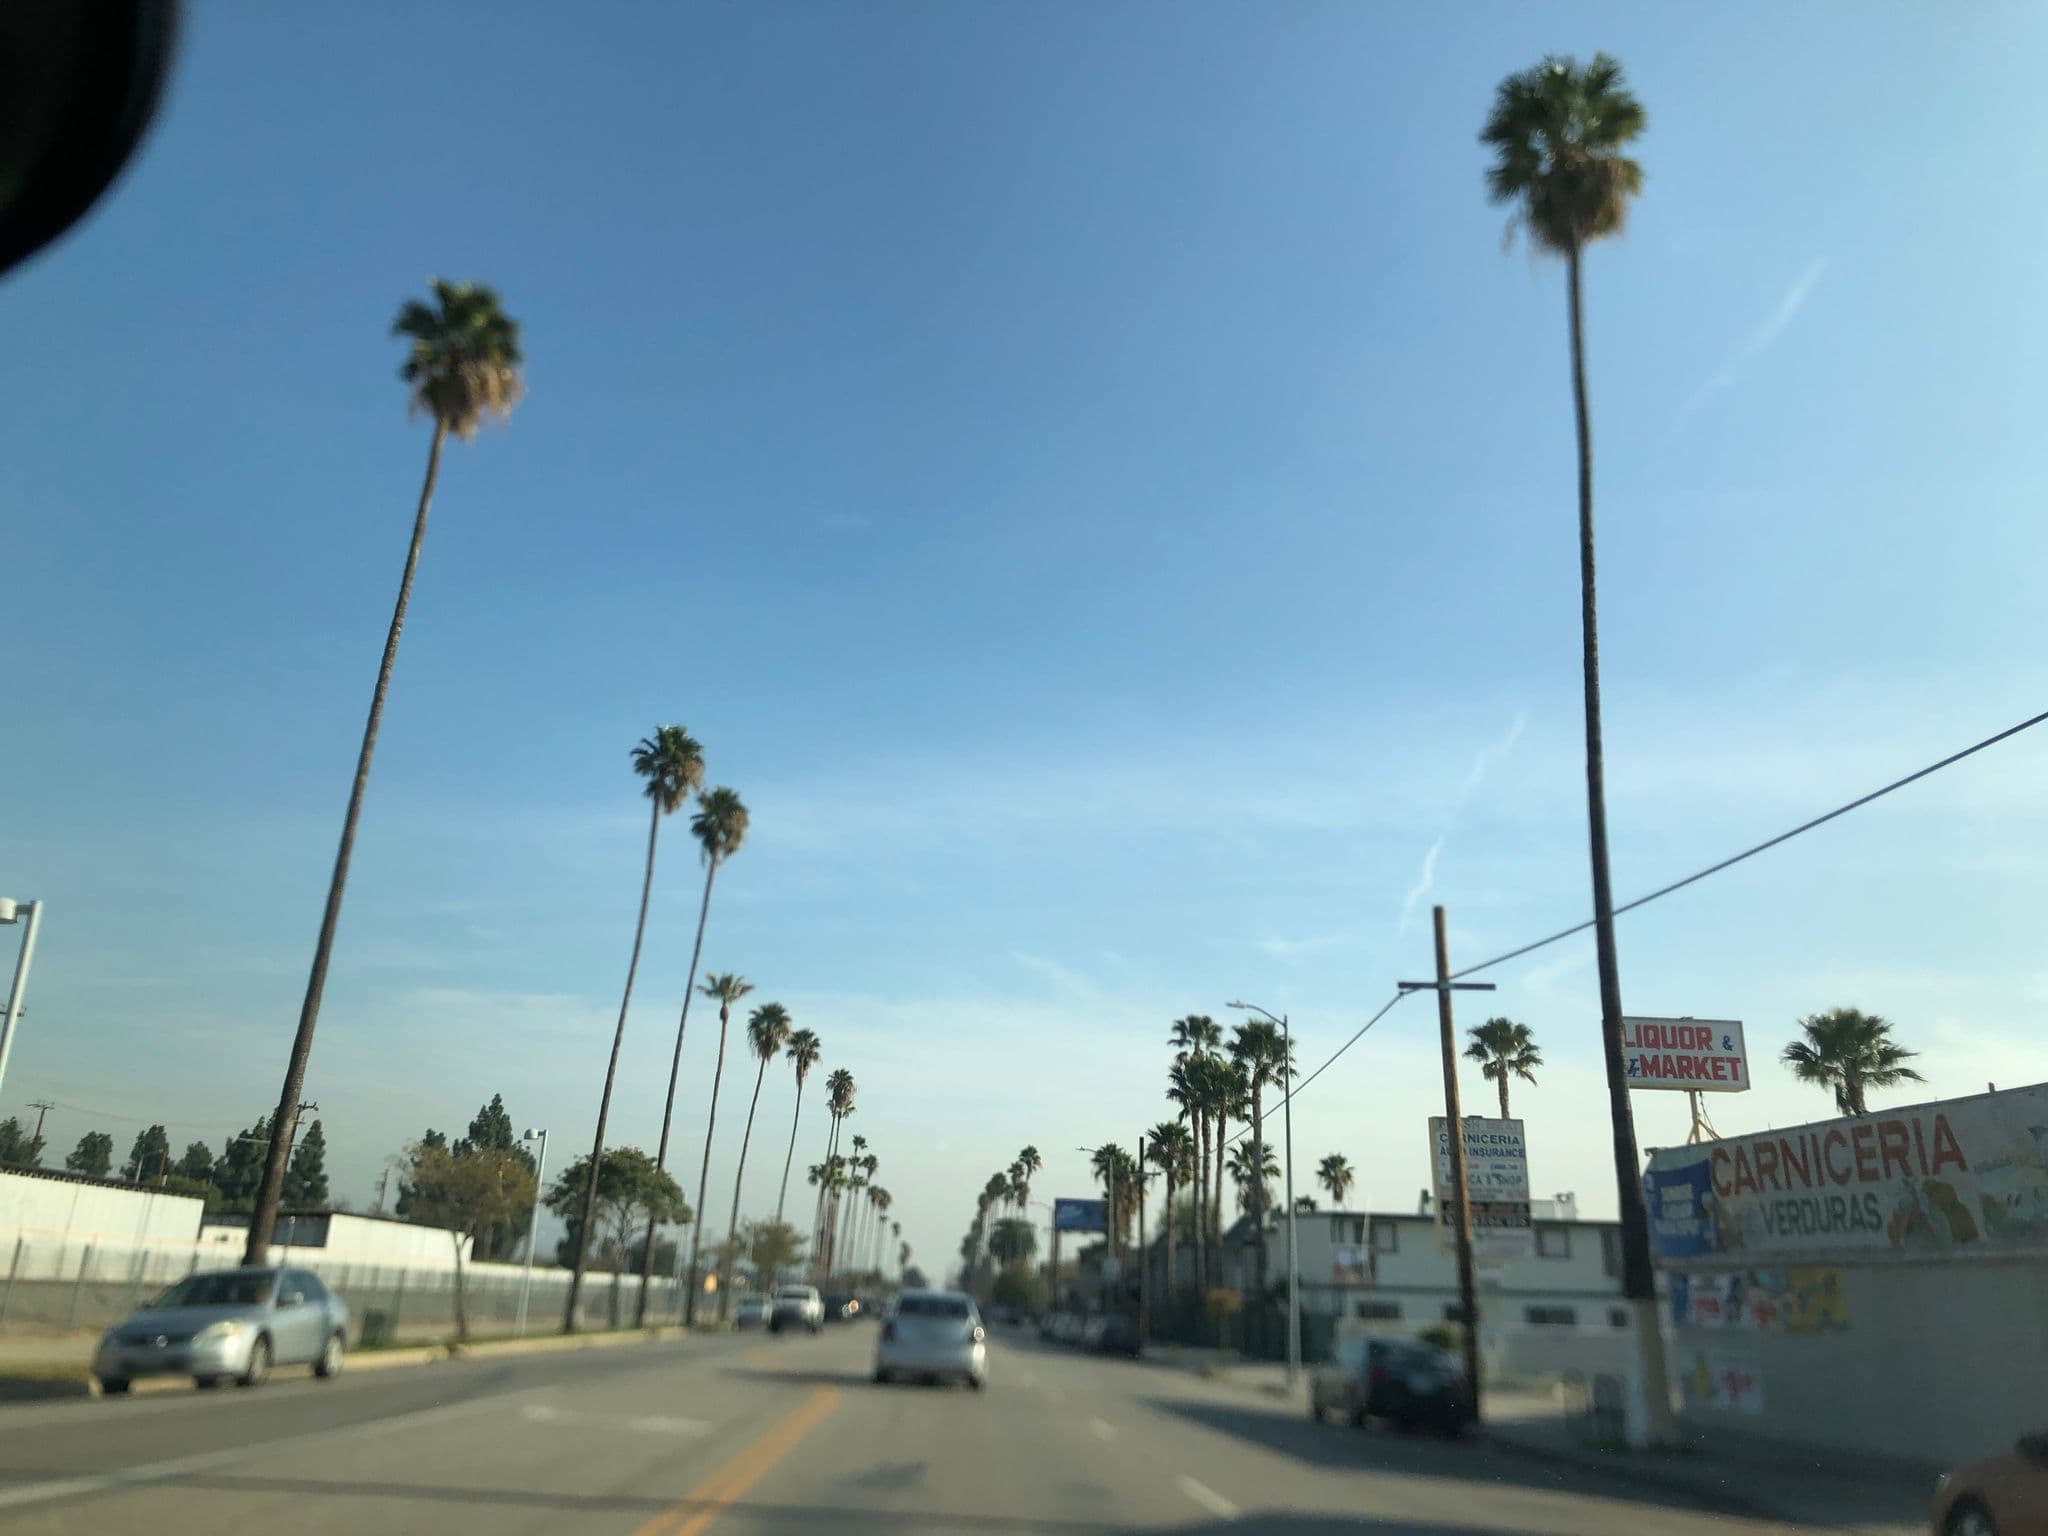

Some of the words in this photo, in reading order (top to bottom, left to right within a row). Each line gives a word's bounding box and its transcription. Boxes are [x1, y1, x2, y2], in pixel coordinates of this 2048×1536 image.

[1622, 1024, 1713, 1050] LIQUOR
[1722, 1035, 1733, 1051] &
[1640, 1054, 1741, 1081] MARKET
[1439, 1133, 1520, 1144] CNICERIA
[1469, 1147, 1525, 1158] INSURANCE
[1711, 1113, 1969, 1197] CARNICERIA
[1761, 1192, 1883, 1235] VERDURAS
